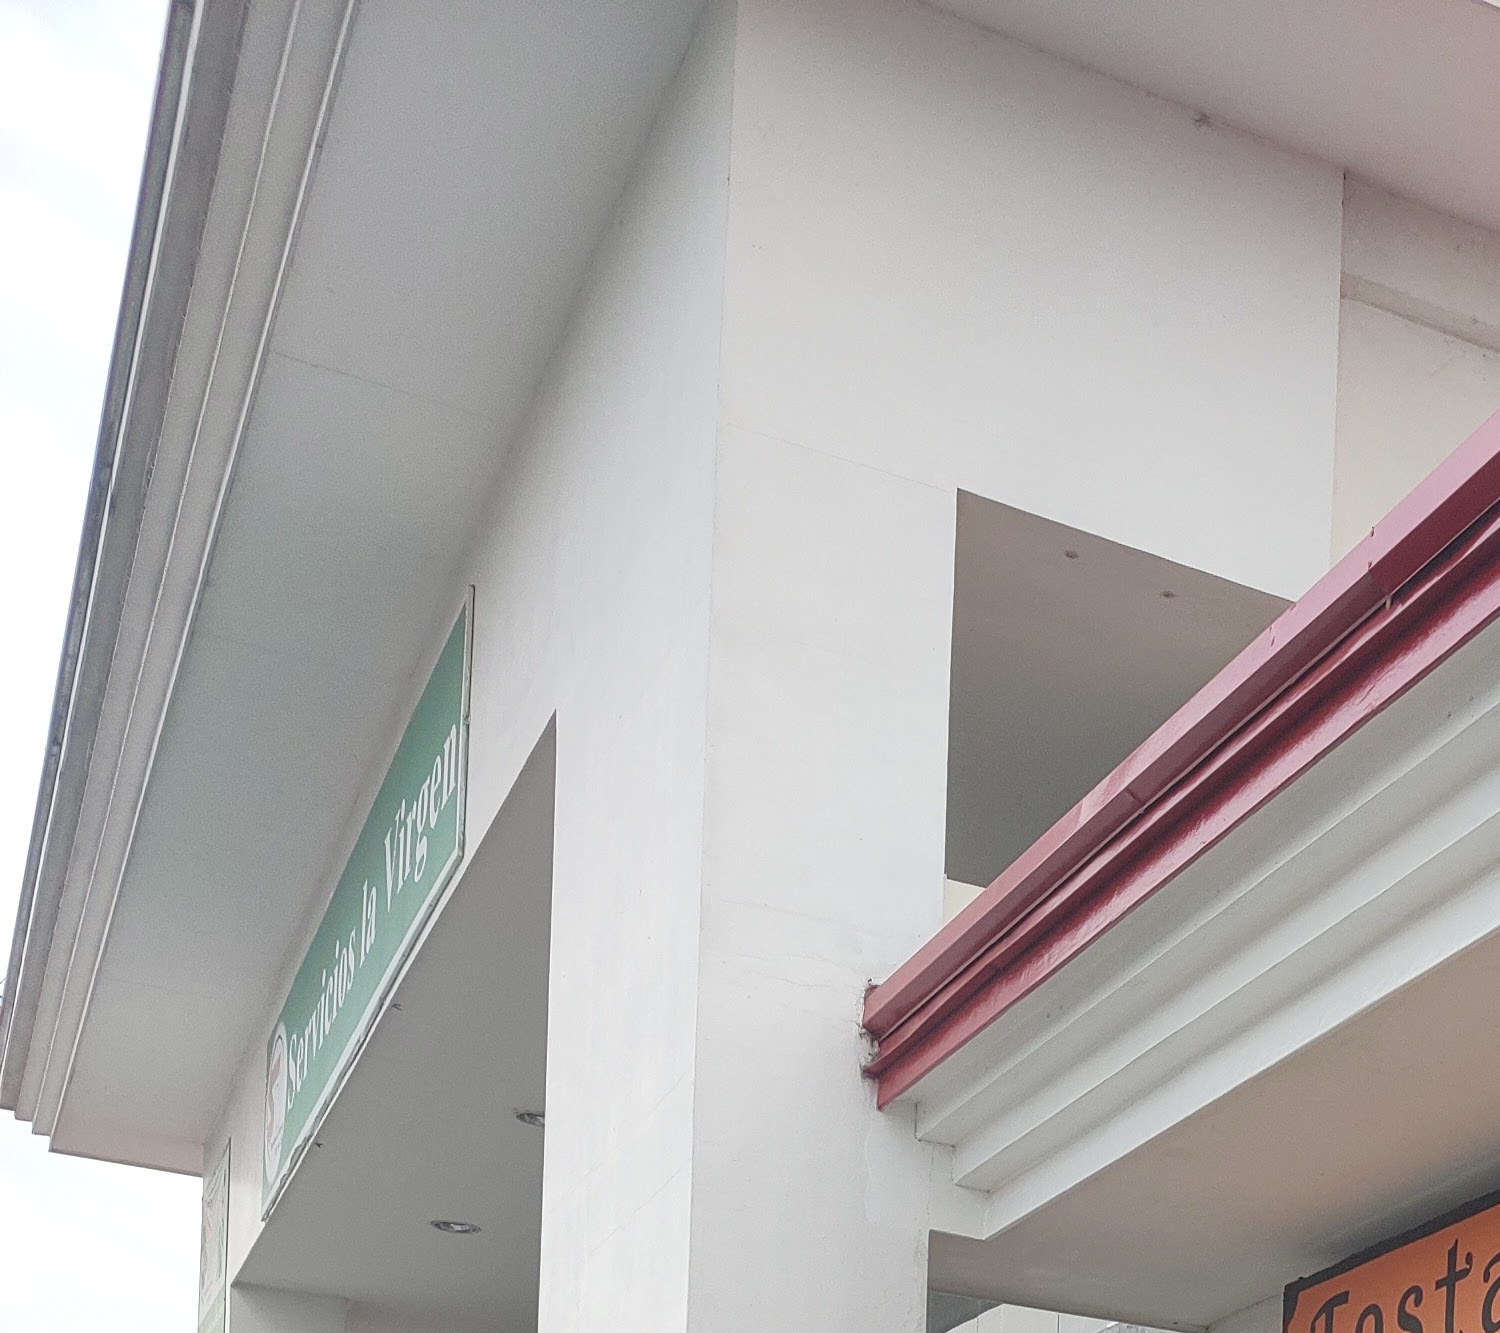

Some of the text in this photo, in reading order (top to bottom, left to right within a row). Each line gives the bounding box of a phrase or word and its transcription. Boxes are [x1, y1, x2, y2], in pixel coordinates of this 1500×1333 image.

[285, 723, 457, 1111] Servicios la Virgen
